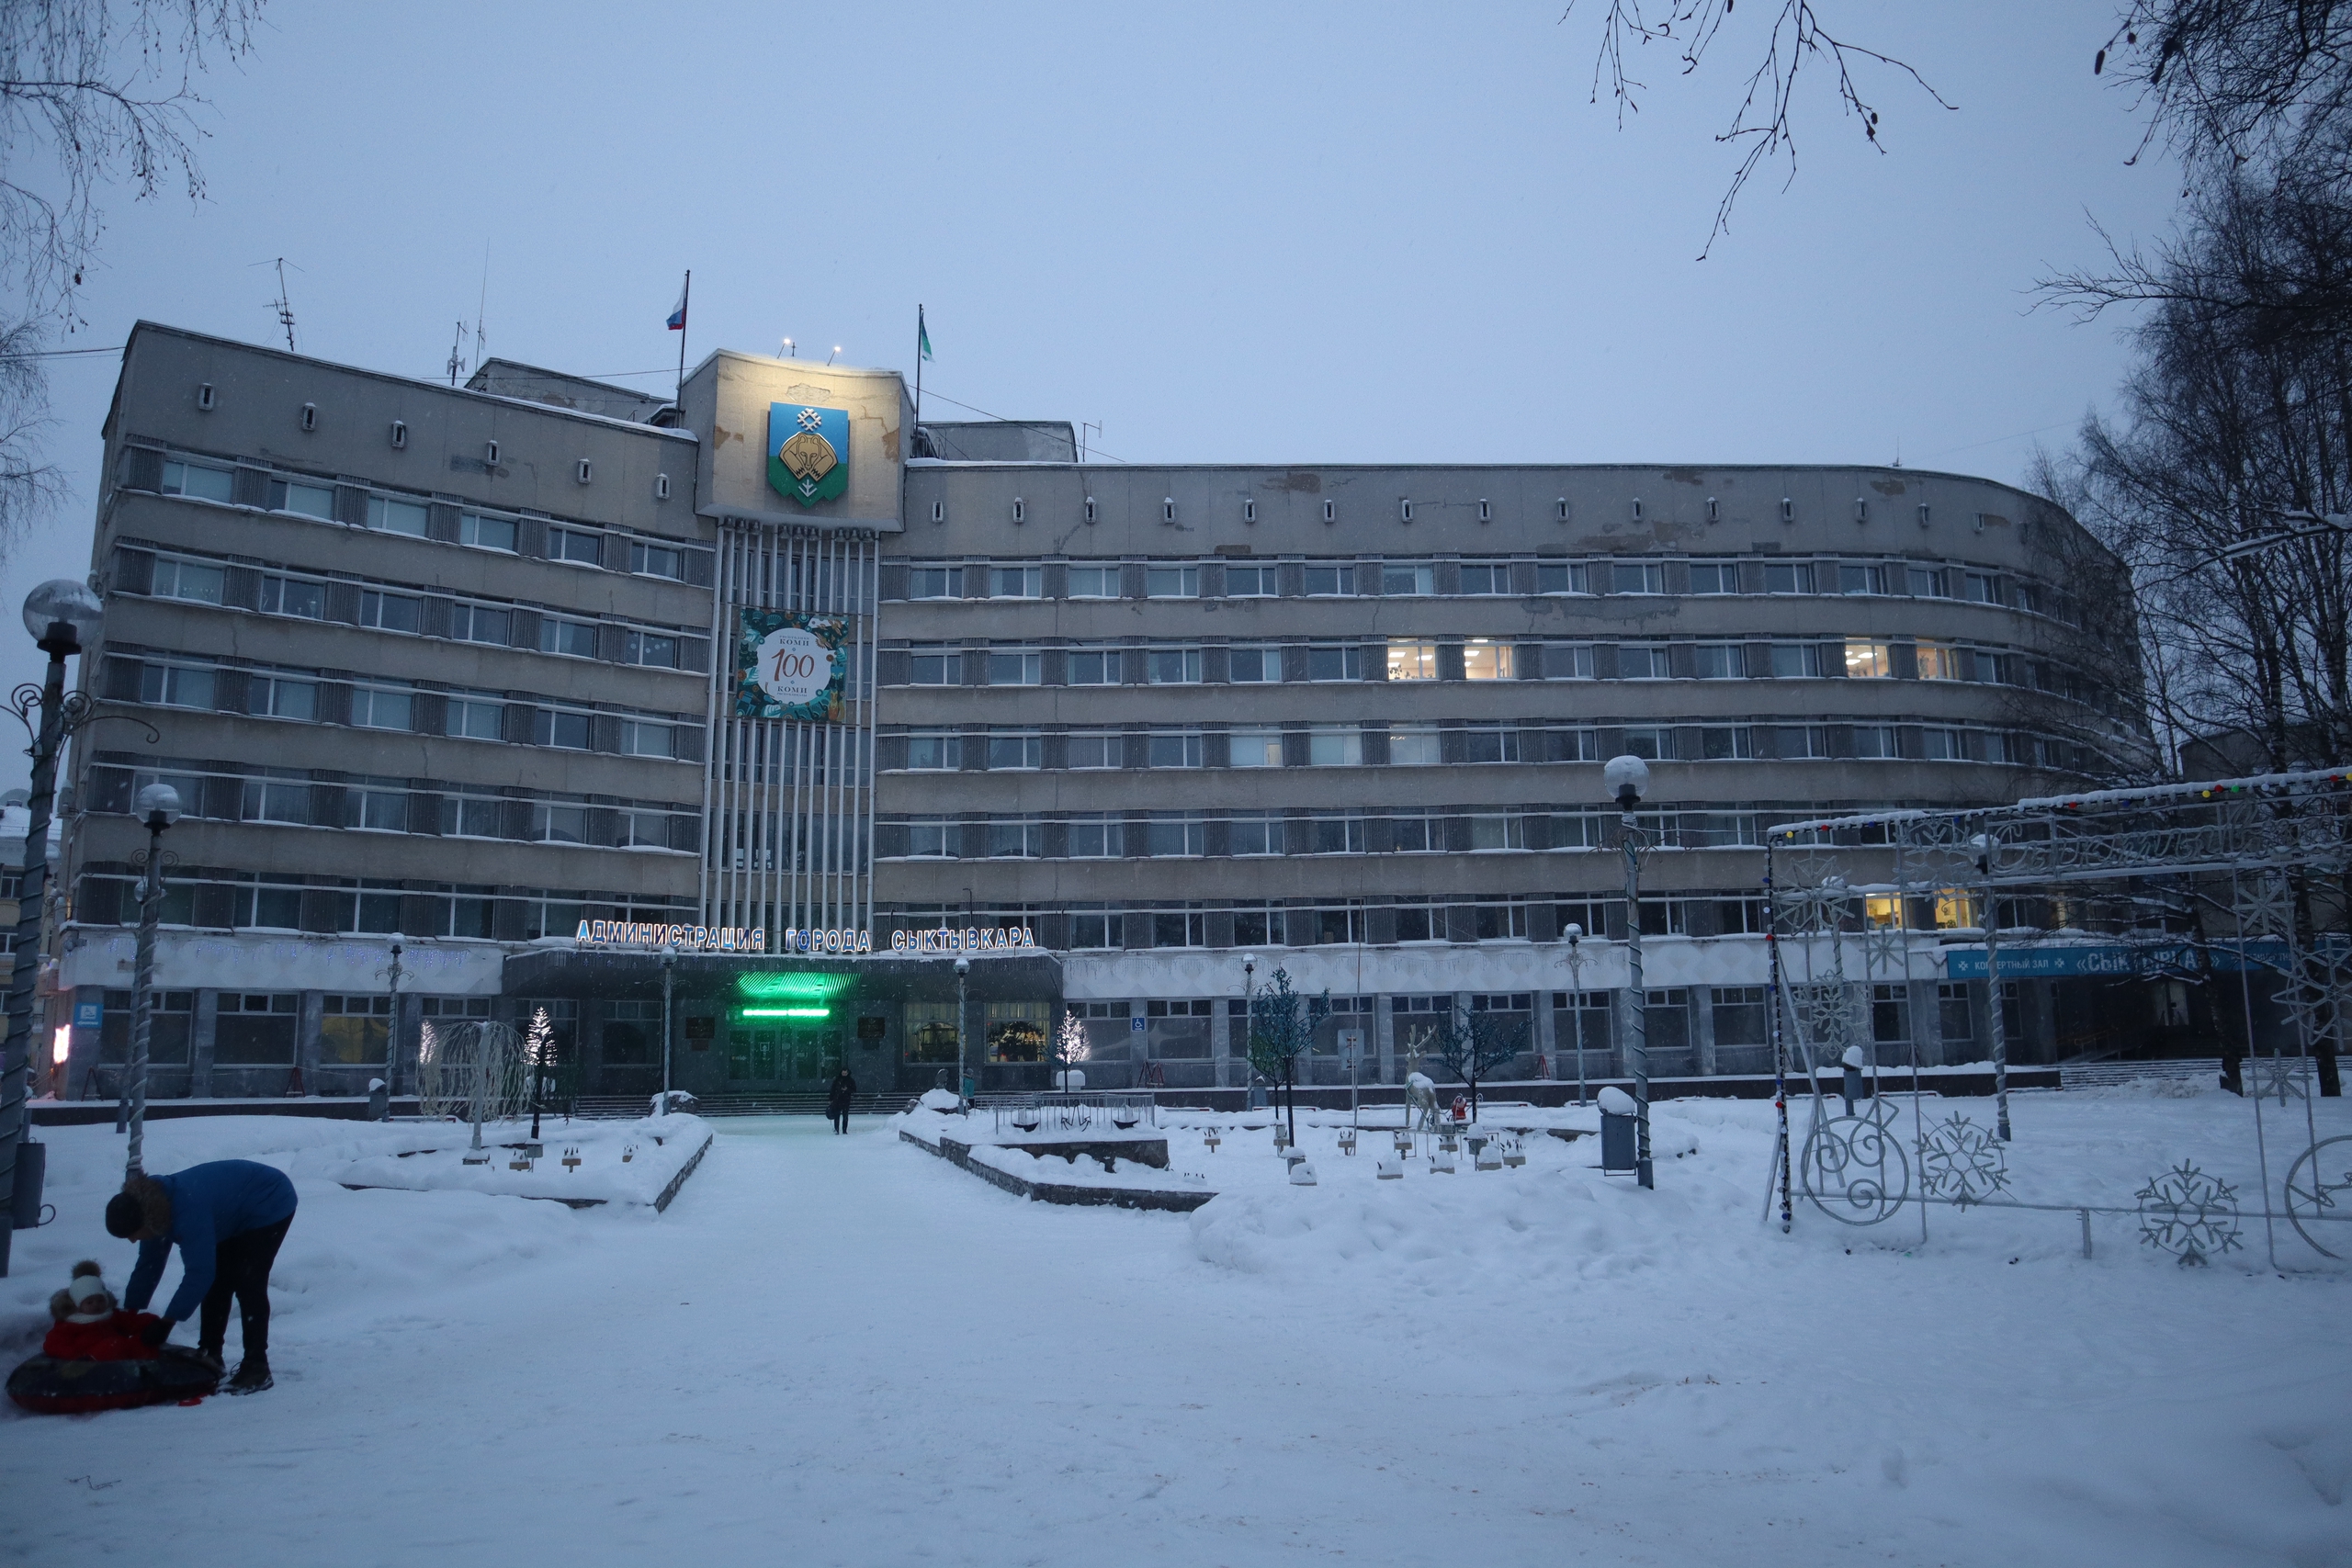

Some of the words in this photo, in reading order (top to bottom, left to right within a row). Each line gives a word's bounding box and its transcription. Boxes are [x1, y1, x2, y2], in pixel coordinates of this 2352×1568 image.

[771, 649, 815, 682] 100
[576, 919, 765, 950] АДМИНИСТРАЦИЯ
[786, 928, 872, 953] ГОРОДА
[892, 927, 1035, 952] СЫКТЫВКАРА
[1974, 958, 2030, 971] КОЕРТНЫЙ
[2032, 959, 2049, 968] ЗАЛ
